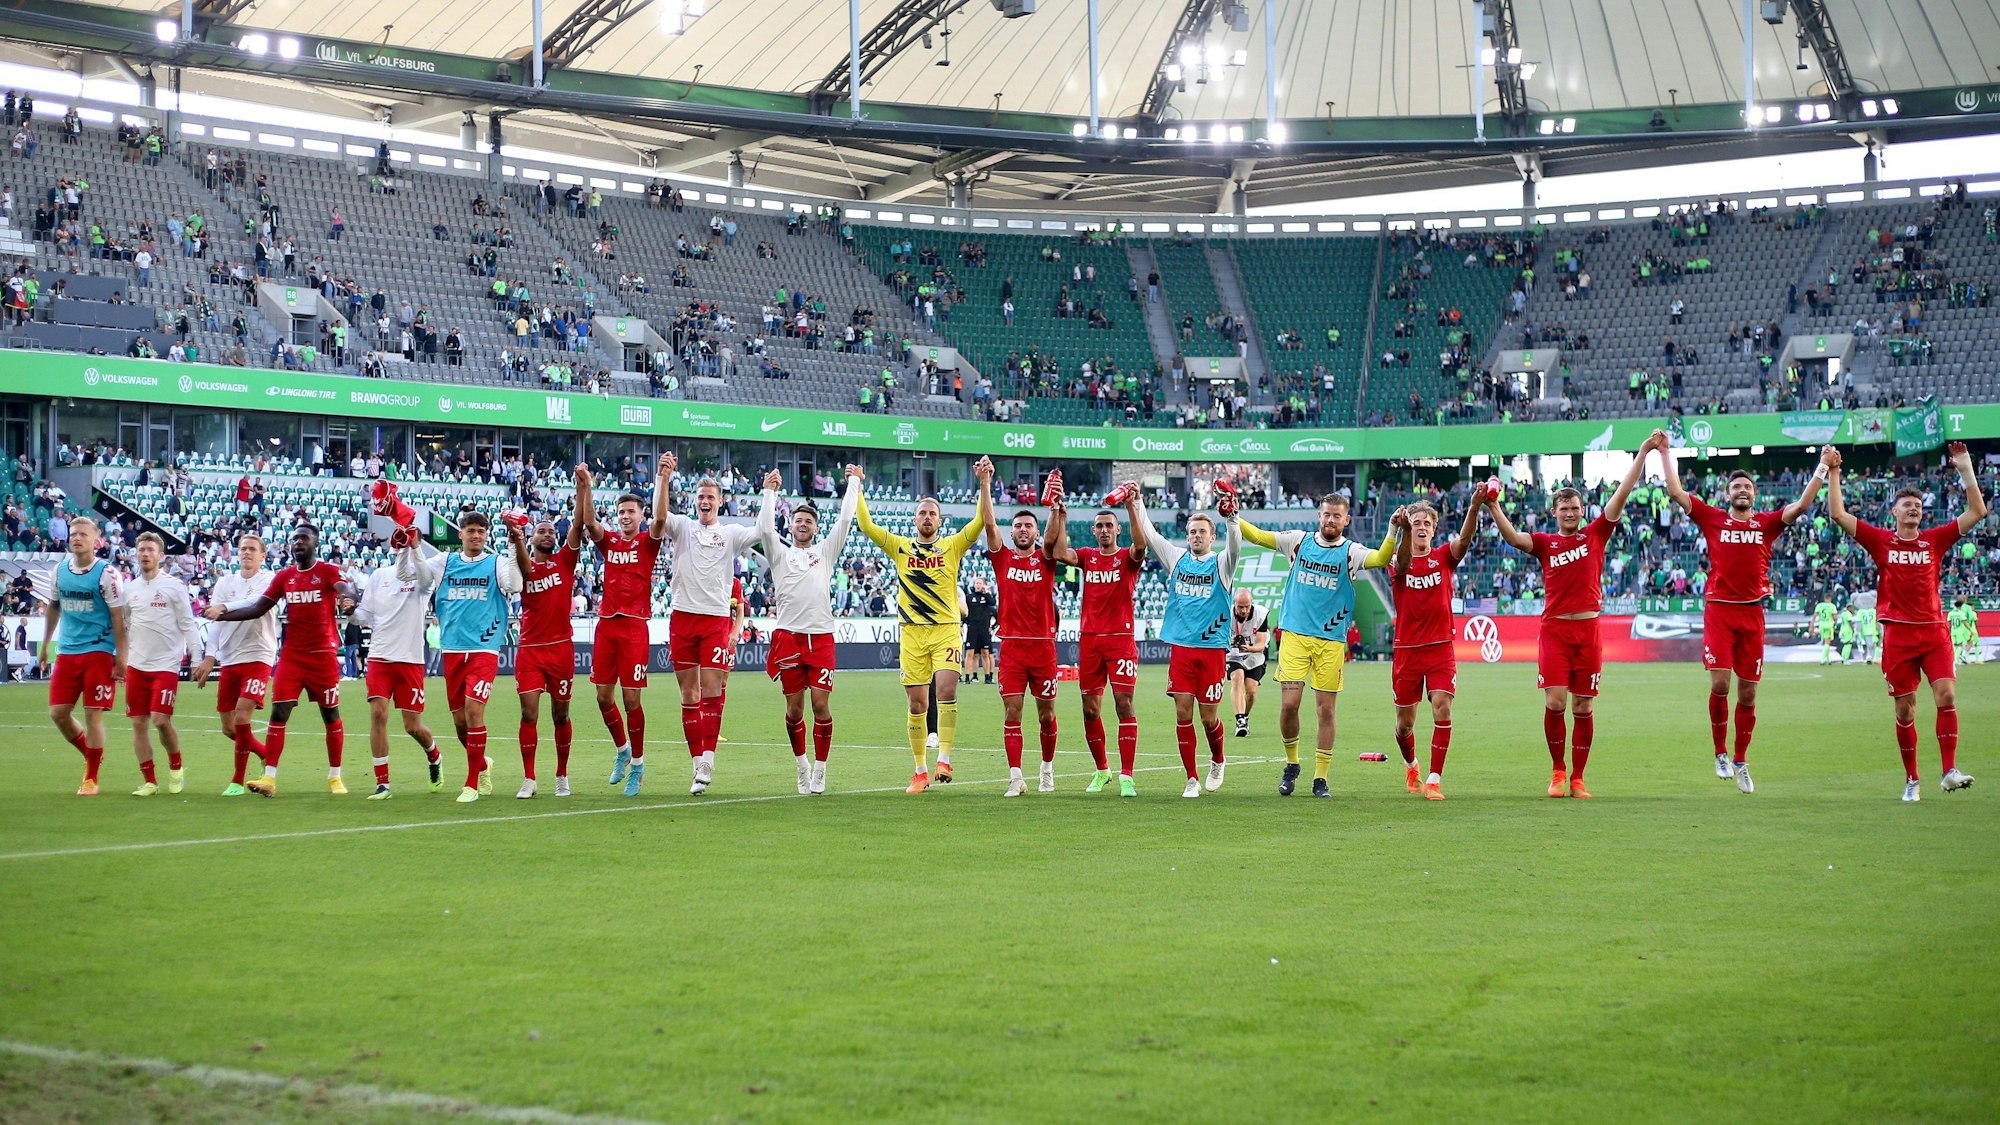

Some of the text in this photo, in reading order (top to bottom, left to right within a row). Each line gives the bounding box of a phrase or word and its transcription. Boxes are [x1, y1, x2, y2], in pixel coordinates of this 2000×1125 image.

[346, 51, 363, 63] VfL
[369, 53, 435, 72] WOLFSBURG
[287, 291, 297, 299] 58
[617, 322, 626, 330] 60
[102, 373, 158, 387] VOLKSWAGEN
[195, 381, 248, 394] VOLKSWAGEN
[281, 388, 337, 400] LINGLONG TIRE
[351, 392, 421, 407] BRAWOGROUP
[468, 401, 508, 411] WOLFSBURG
[623, 405, 649, 423] DÜRR
[1003, 432, 1036, 448] CHG
[1071, 437, 1106, 449] VELTINS
[1148, 439, 1184, 452] hexad
[1246, 443, 1271, 451] MOLL
[1720, 529, 1764, 545] REWE
[607, 549, 638, 565] REWE
[907, 556, 946, 569] REWE
[1550, 543, 1589, 569] REWE
[1888, 550, 1932, 565] REWE
[1298, 554, 1342, 575] hummel
[448, 575, 489, 587] hummel
[1007, 566, 1043, 583] REWE
[1085, 568, 1120, 584] REWE
[1176, 569, 1214, 585] hummel
[1297, 570, 1339, 591] REWE
[1405, 571, 1442, 590] REWE
[526, 572, 563, 595] REWE
[1174, 581, 1212, 600] REWE
[286, 589, 323, 605] REWE
[447, 587, 488, 601] REWE
[60, 599, 95, 612] REWE
[711, 647, 726, 665] 21
[945, 647, 960, 665] 20
[1115, 658, 1133, 677] 28
[818, 668, 834, 686] 29
[473, 680, 491, 699] 46
[1041, 679, 1057, 696] 23
[1205, 682, 1221, 701] 48
[160, 689, 172, 706] 11
